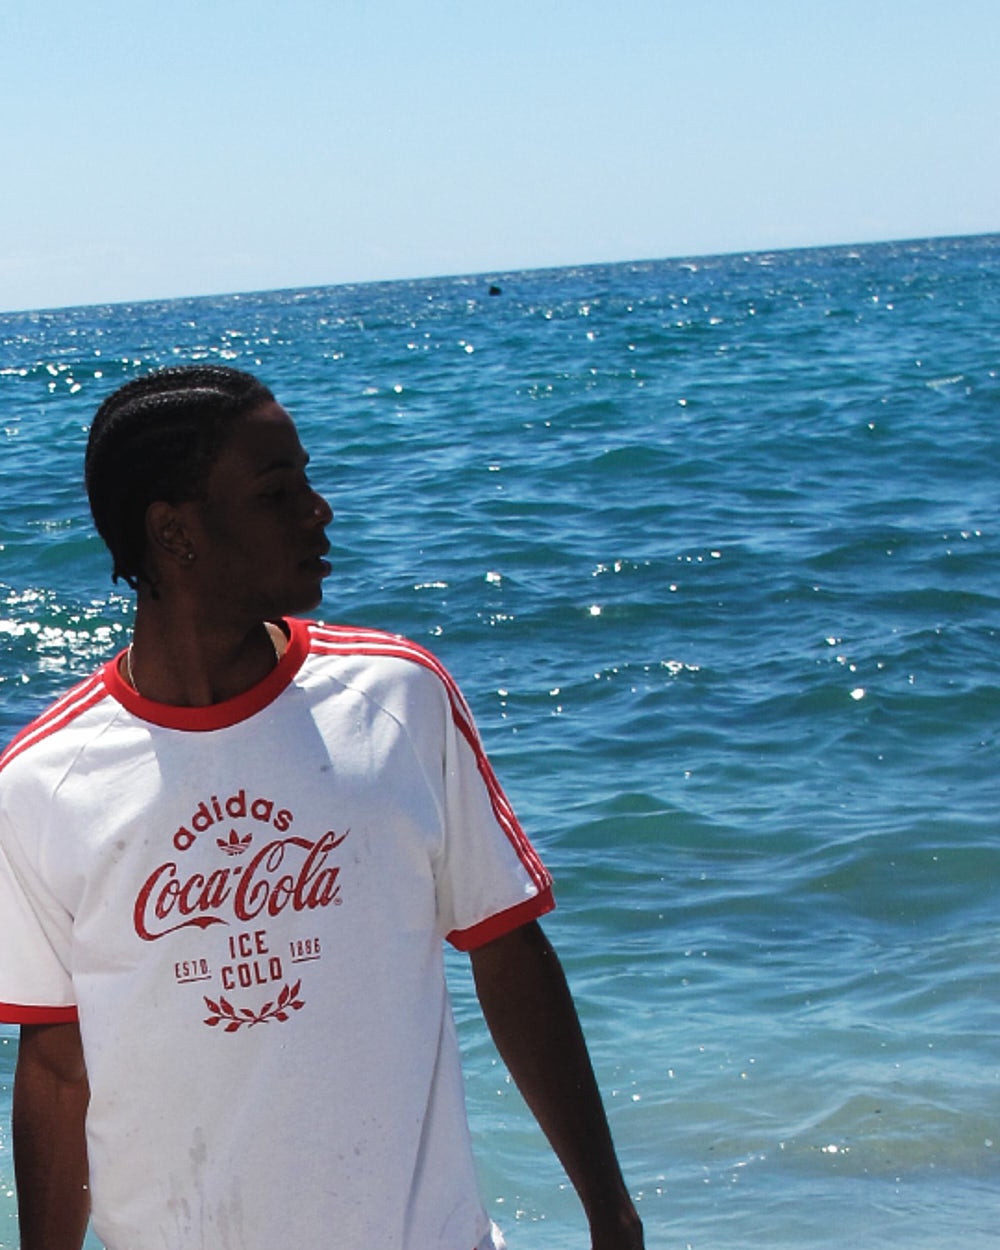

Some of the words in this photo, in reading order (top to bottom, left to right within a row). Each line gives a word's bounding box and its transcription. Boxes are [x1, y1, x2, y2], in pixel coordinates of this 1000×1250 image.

[173, 789, 293, 851] adidas
[133, 828, 350, 941] Coca-Cola
[229, 930, 269, 959] ICE
[221, 957, 282, 990] COLD
